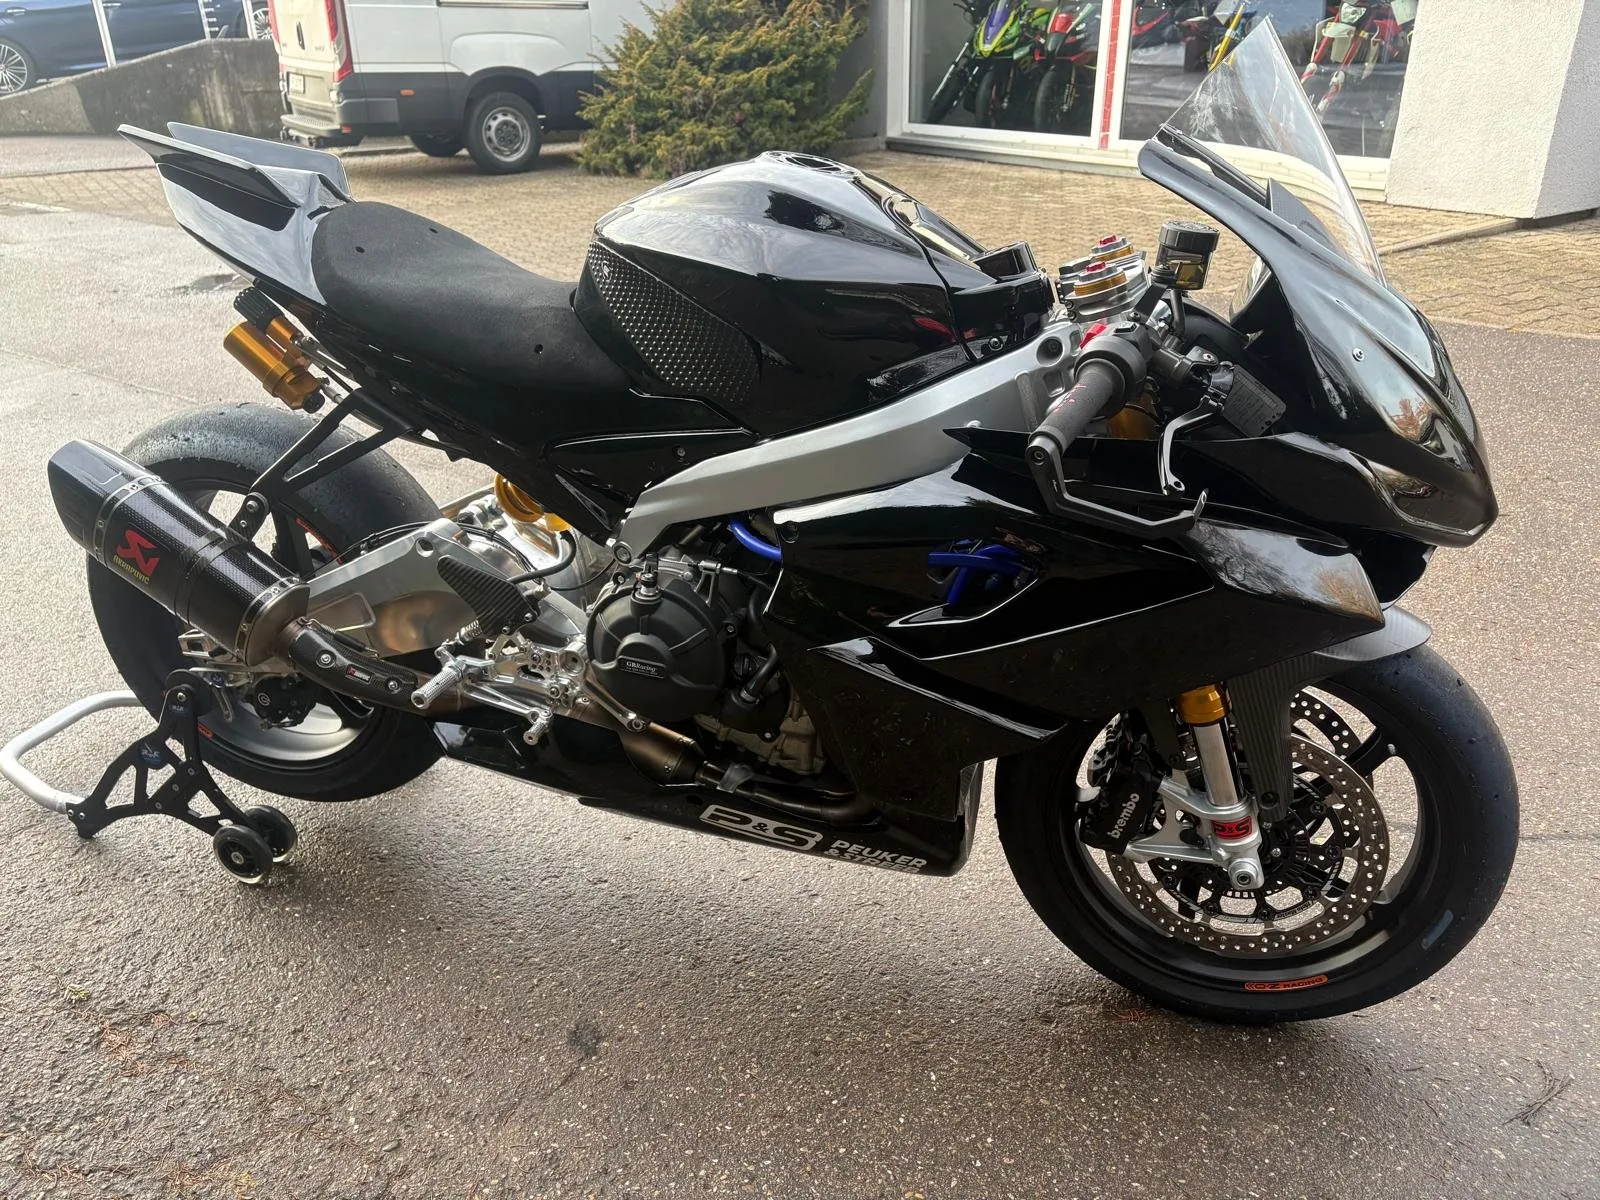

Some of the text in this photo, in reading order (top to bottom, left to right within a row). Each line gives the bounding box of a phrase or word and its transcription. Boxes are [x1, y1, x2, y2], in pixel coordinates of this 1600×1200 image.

[706, 807, 818, 846] P&S
[1107, 792, 1140, 839] brembo
[1213, 818, 1250, 838] P&S
[830, 839, 928, 868] PEUKER
